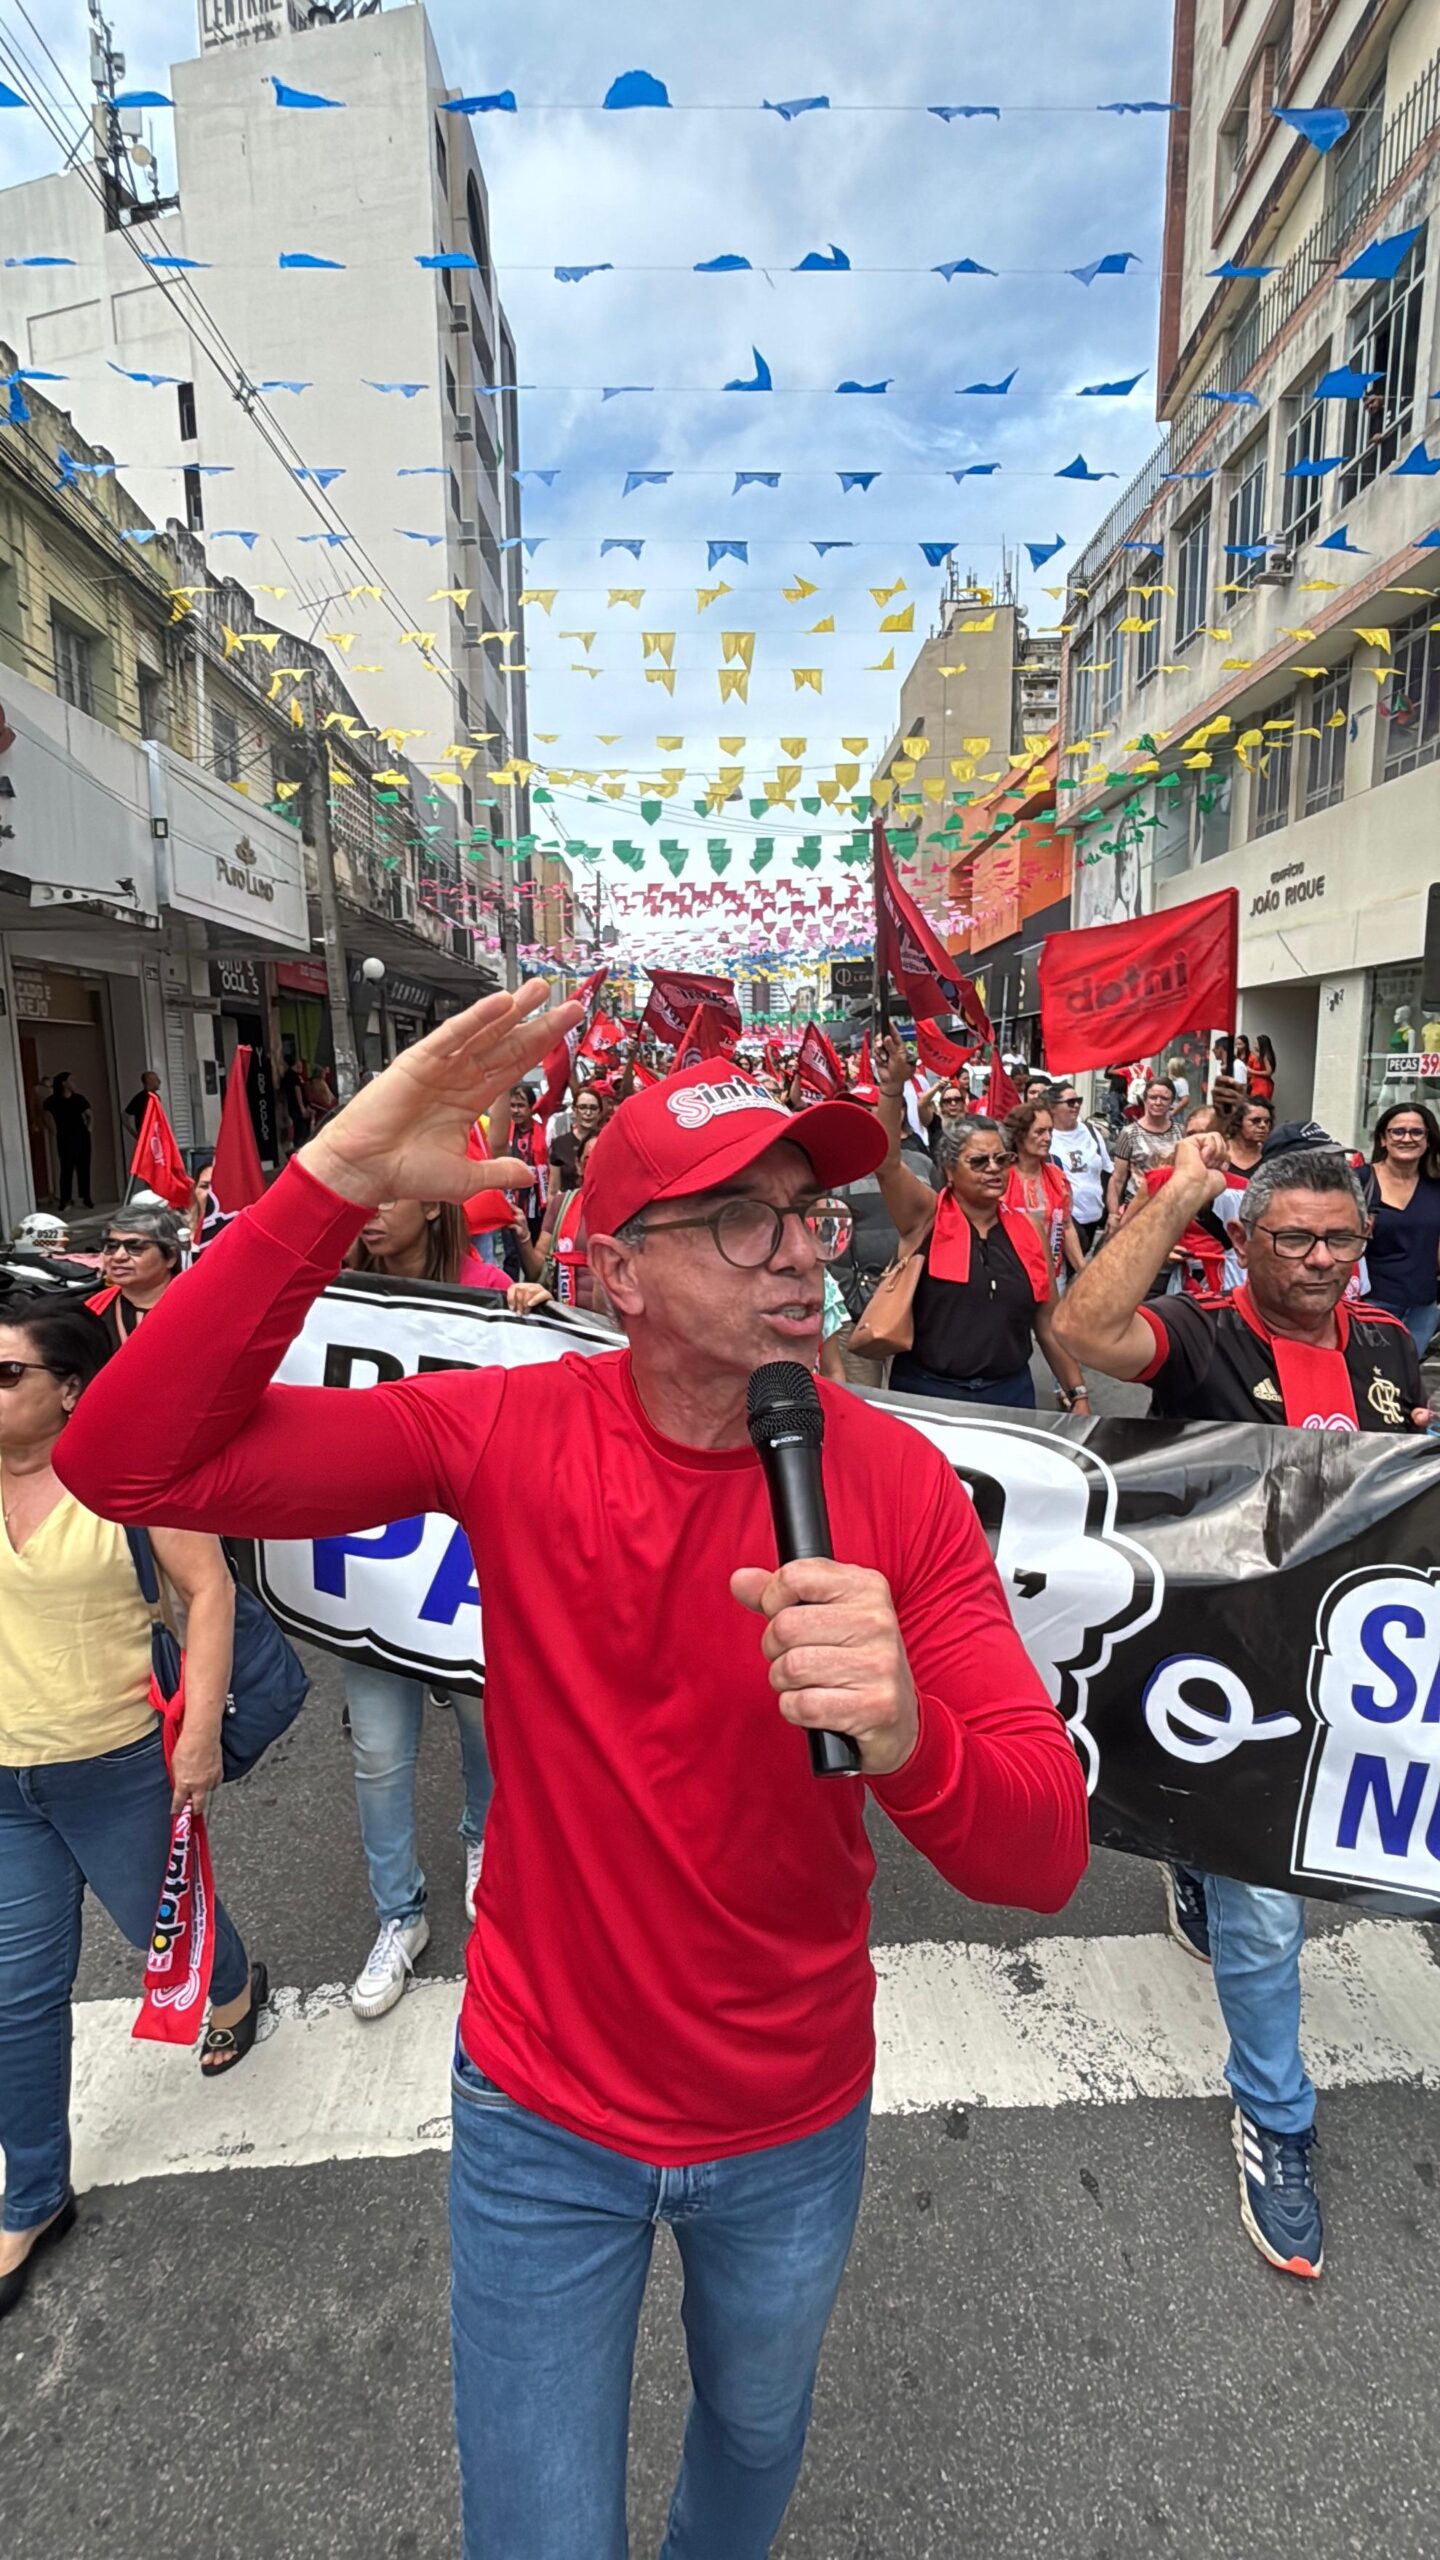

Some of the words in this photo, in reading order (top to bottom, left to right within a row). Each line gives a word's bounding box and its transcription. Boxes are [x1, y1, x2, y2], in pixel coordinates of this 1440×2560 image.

[1249, 889, 1280, 917] JOÃO
[1285, 874, 1326, 907] RIQUE
[667, 1076, 779, 1128] Sinta
